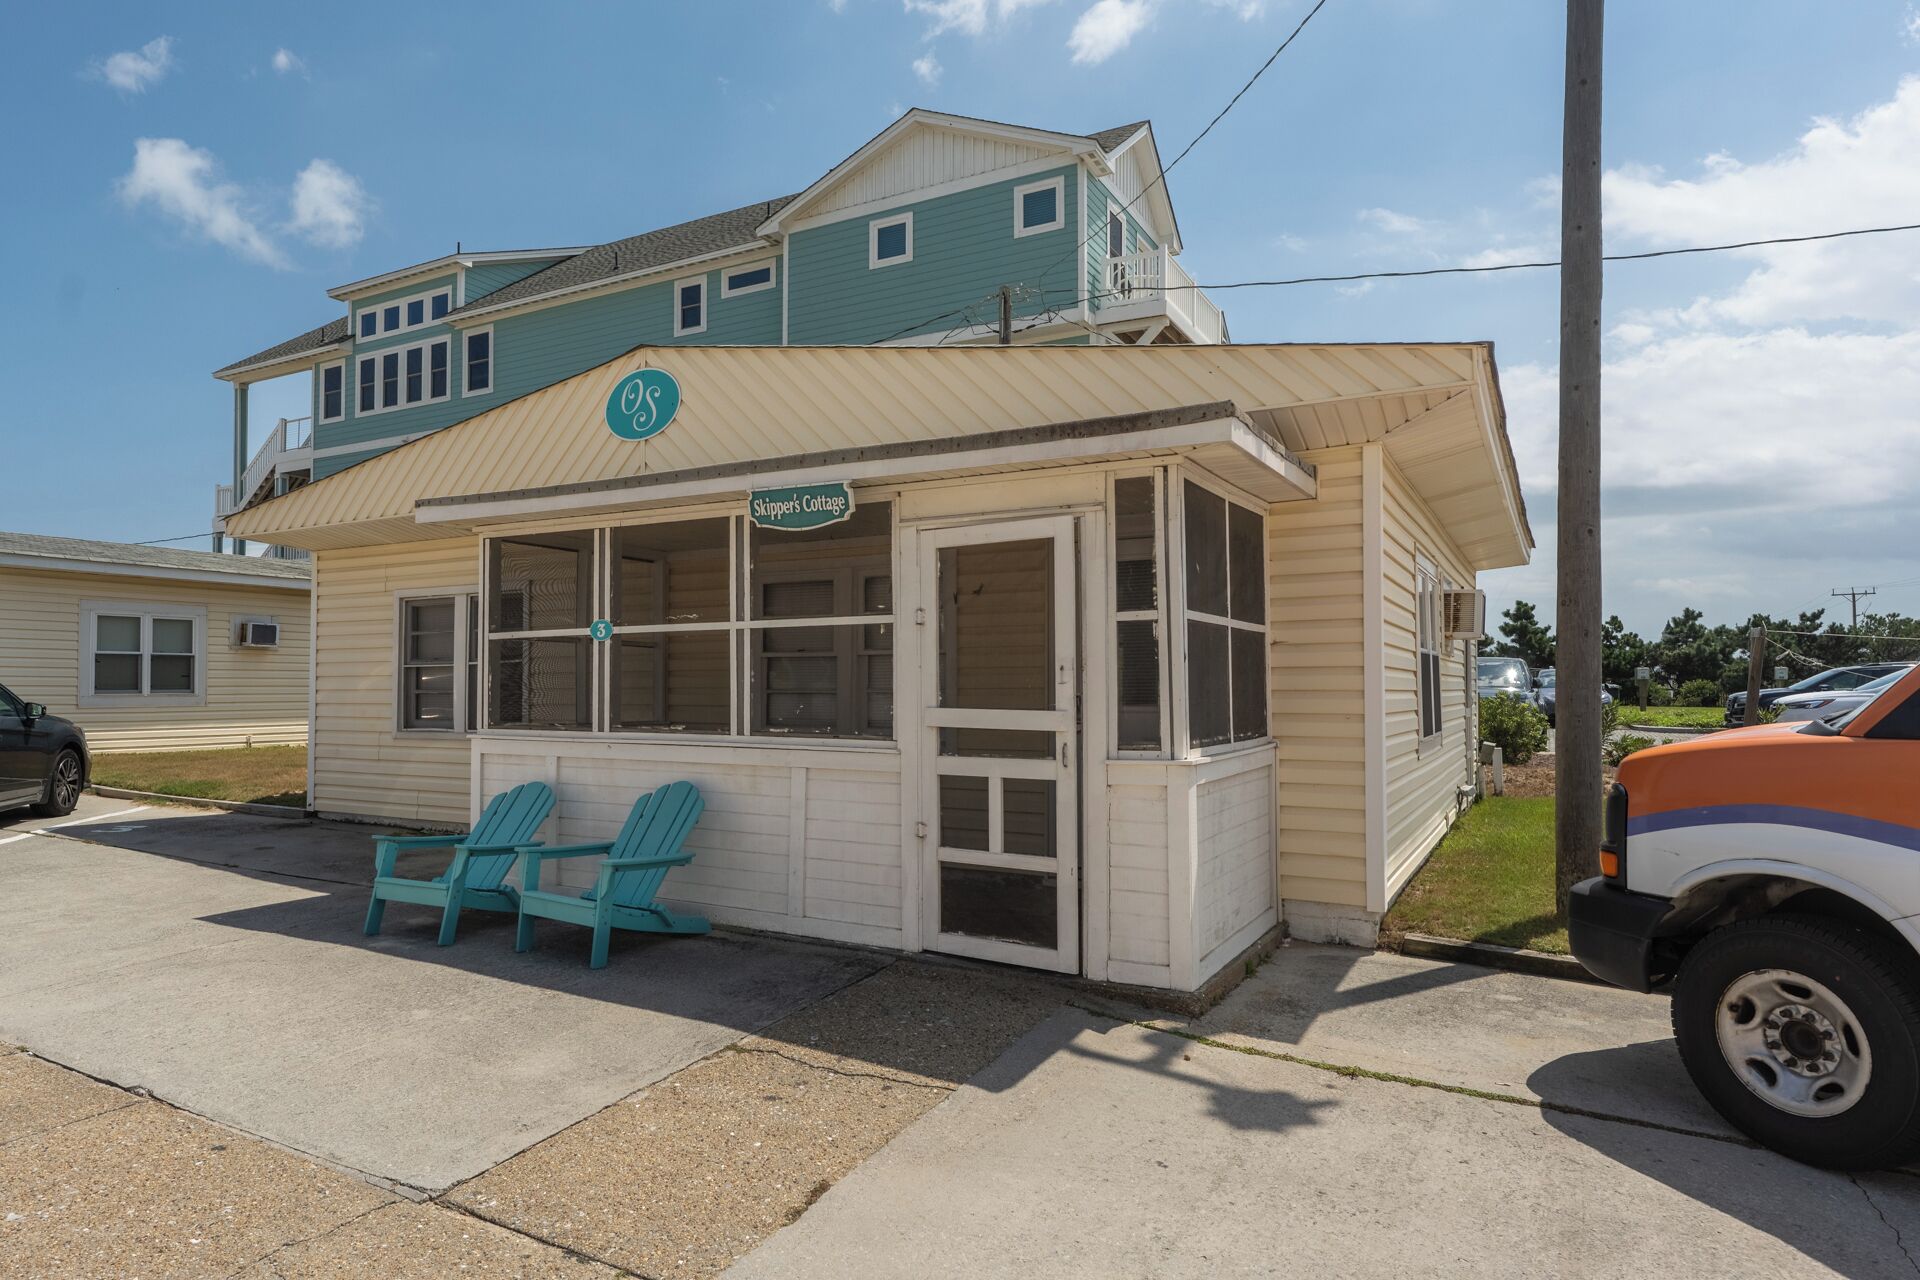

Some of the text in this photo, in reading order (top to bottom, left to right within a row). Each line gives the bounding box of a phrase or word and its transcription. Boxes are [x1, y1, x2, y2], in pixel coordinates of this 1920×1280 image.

[753, 493, 846, 520] Skipper's Cottage
[597, 623, 606, 638] 3
